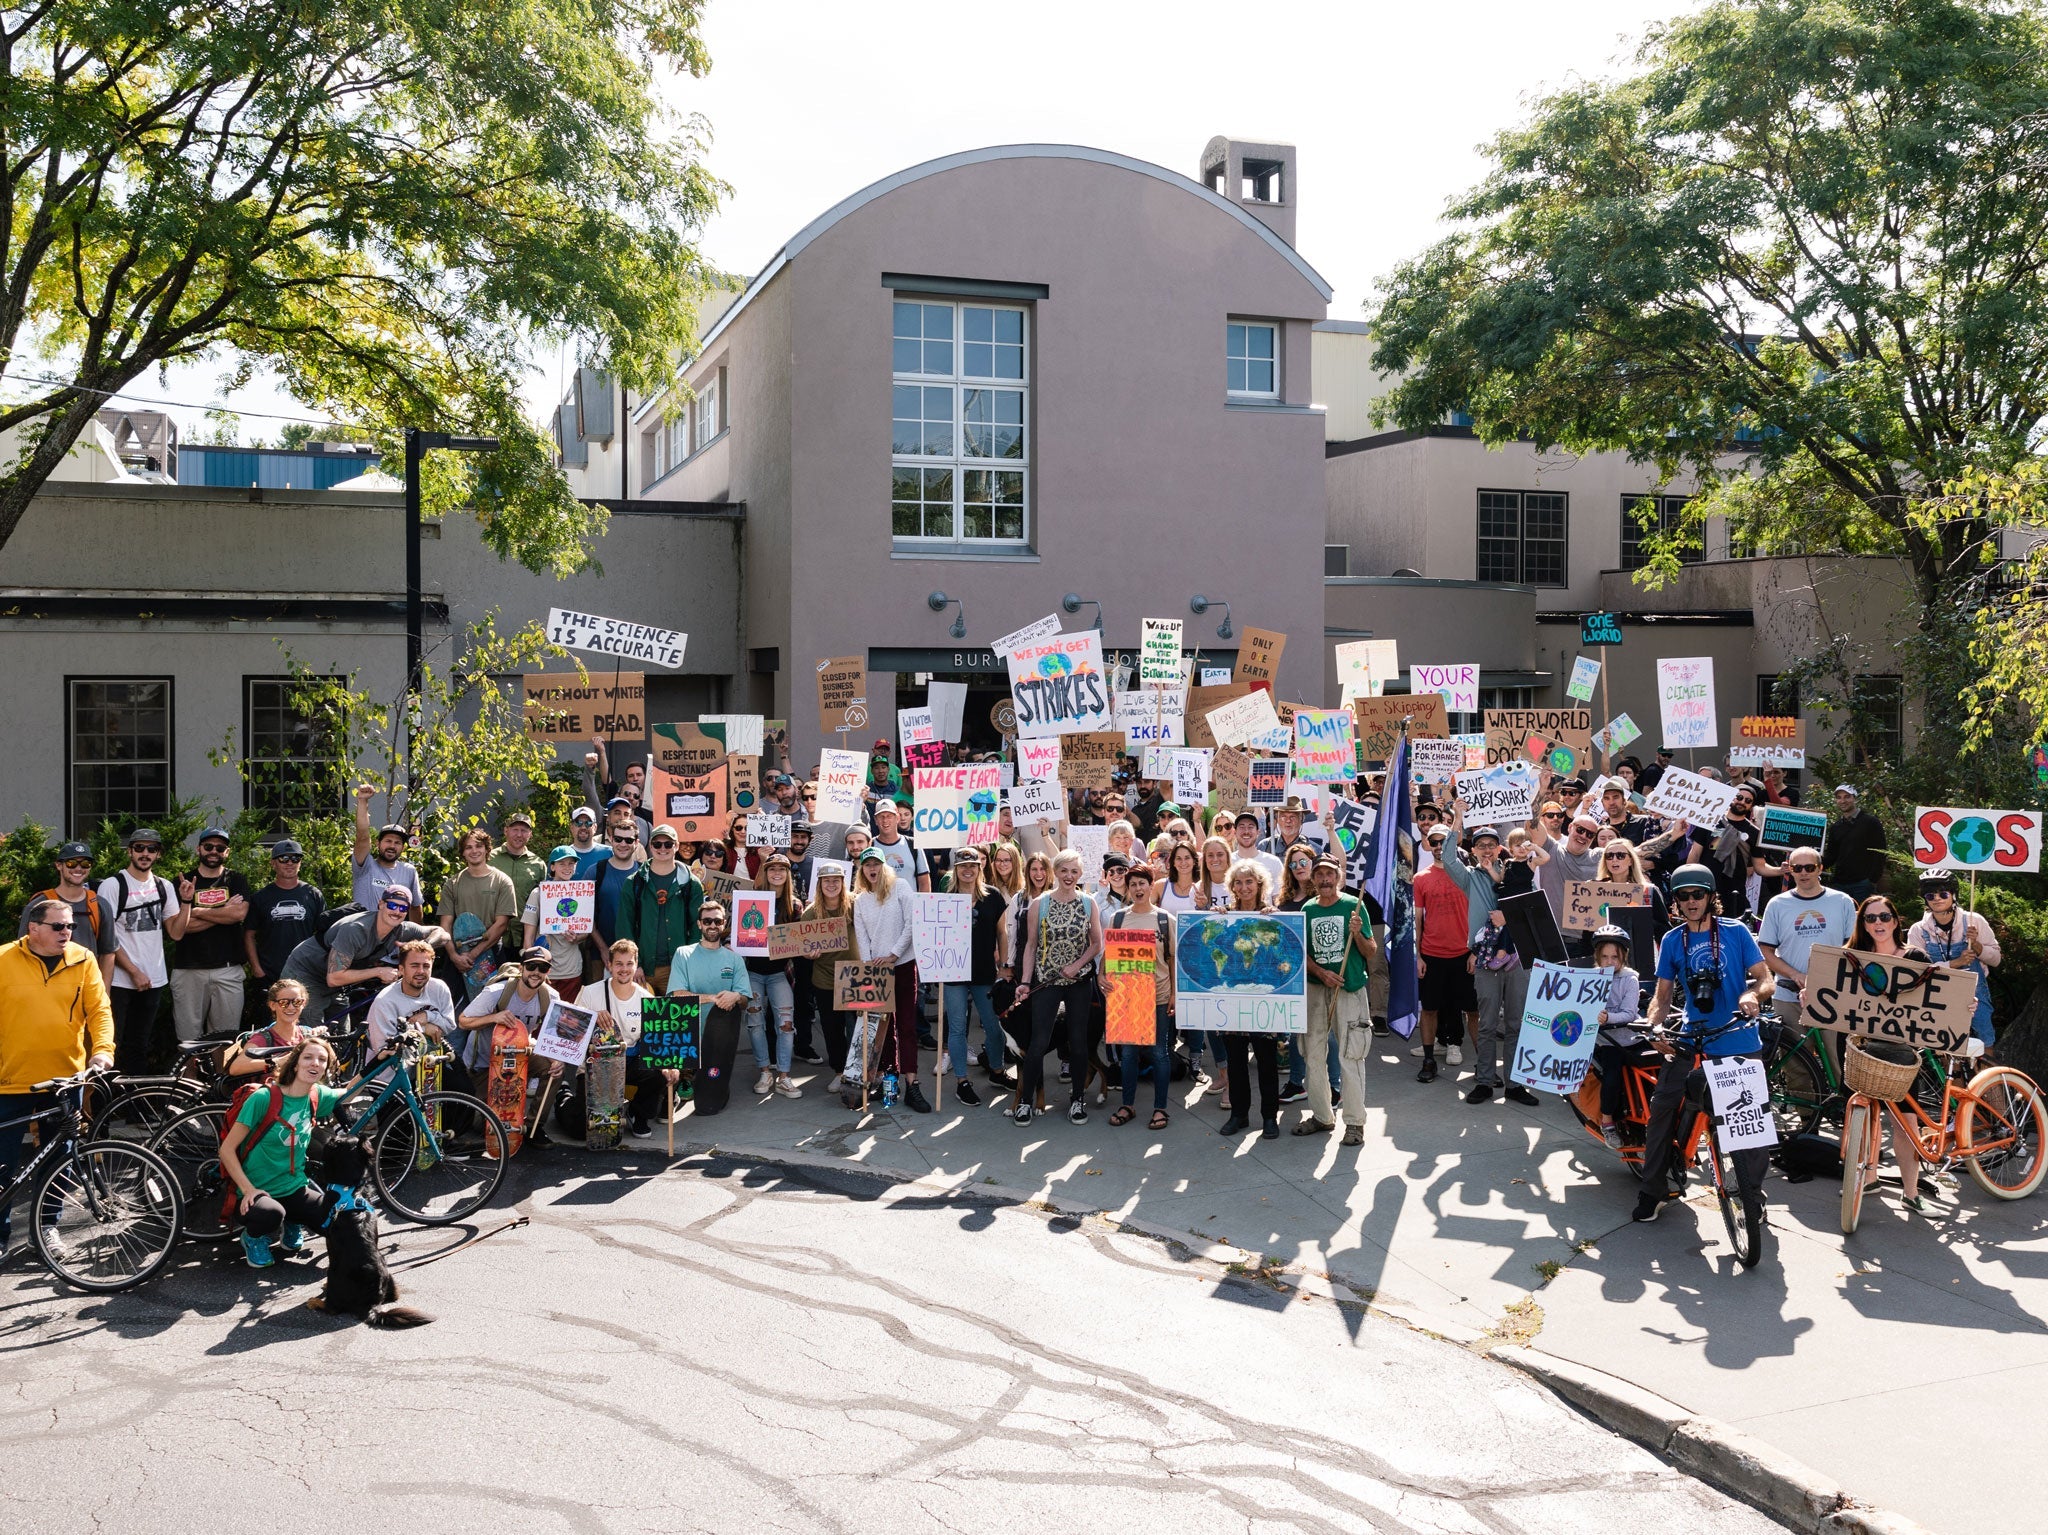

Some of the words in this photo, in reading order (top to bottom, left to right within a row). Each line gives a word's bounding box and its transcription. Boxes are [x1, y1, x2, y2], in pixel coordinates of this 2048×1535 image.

[561, 611, 600, 629] THE
[605, 620, 679, 645] SCIENCE
[1170, 622, 1181, 631] UP
[1588, 613, 1615, 628] ONE
[1156, 632, 1173, 640] AND
[1252, 637, 1274, 650] ONLY
[552, 627, 576, 644] IS
[586, 634, 682, 664] ACCURATE
[1013, 649, 1033, 661] WE
[1065, 638, 1091, 653] GET
[1251, 651, 1268, 663] ONE
[821, 672, 847, 682] CLOSED
[847, 672, 861, 680] FOR
[1242, 663, 1269, 679] EARTH
[1417, 667, 1475, 686] YOUR
[822, 682, 855, 691] BUSINESS.
[1666, 685, 1707, 700] CLIMATE
[823, 692, 840, 700] OPEN
[1014, 672, 1105, 723] STRIKES
[1124, 694, 1145, 706] I'VE
[824, 701, 850, 709] ACTION.
[1672, 701, 1706, 718] ACTION
[594, 714, 643, 732] DEAD.
[1369, 721, 1384, 732] the
[1488, 711, 1590, 729] WATERWORLD
[904, 730, 912, 740] IS
[1131, 725, 1171, 739] IKEA
[1740, 725, 1796, 738] CLIMATE
[1062, 743, 1104, 754] ANSWER
[1109, 742, 1121, 751] IS
[1066, 734, 1090, 753] THE
[1367, 731, 1397, 758] AREA
[1415, 743, 1459, 752] FIGHTING
[663, 750, 697, 760] RESPECT
[700, 749, 716, 760] OUR
[904, 745, 917, 758] I
[1023, 745, 1059, 759] WAKE
[1432, 753, 1460, 761] CHANGE
[1730, 744, 1805, 759] EMERGENCY
[908, 752, 942, 768] THE
[1178, 759, 1192, 768] KEEP
[668, 764, 711, 775] EXISTANCE
[1030, 762, 1053, 777] UP
[684, 779, 696, 789] OR
[918, 769, 967, 790] MAKE
[969, 768, 1000, 789] EARTH
[1250, 774, 1287, 790] NOW
[1458, 776, 1486, 794] SAVE
[1666, 773, 1707, 794] COAL,
[1025, 788, 1041, 798] GET
[1178, 791, 1203, 799] GROUND
[1463, 790, 1493, 812] BABY
[1494, 789, 1529, 807] SHARK
[1014, 801, 1060, 816] RADICAL
[1665, 787, 1725, 816] REALLY?
[915, 807, 968, 832] COOL
[760, 823, 767, 832] YA
[967, 821, 1000, 845] AGAIN
[1765, 820, 1821, 837] ENVIRONMENTAL
[748, 834, 769, 844] DUMB
[772, 835, 791, 845] IDIOTS
[1764, 831, 1790, 842] JUSTICE
[1915, 810, 2035, 867] SOS
[713, 876, 741, 890] THIS
[924, 900, 964, 923] LET
[1571, 898, 1592, 913] for
[776, 926, 786, 938] I
[800, 922, 827, 934] LOVE
[935, 927, 953, 945] IT
[1106, 931, 1126, 942] OUR
[1127, 931, 1156, 943] HOUSE
[803, 936, 848, 953] SEASONS
[922, 947, 969, 970] SNOW
[1118, 948, 1135, 958] IS
[1138, 948, 1153, 958] ON
[840, 966, 859, 980] NO
[864, 965, 895, 977] SNOW
[849, 977, 887, 988] LOW
[1536, 971, 1571, 1001] NO
[1835, 958, 1949, 1010] HOPE
[842, 987, 891, 1004] BLOW
[643, 998, 670, 1015] MY
[669, 1003, 700, 1020] DOG
[1178, 998, 1228, 1028] IT'S
[1858, 999, 1871, 1010] IS
[1878, 1002, 1919, 1019] NOT
[643, 1020, 689, 1032] NEEDS
[643, 1032, 692, 1045] CLEAN
[649, 1046, 698, 1058] WATER
[1517, 1046, 1536, 1073] IS
[1713, 1070, 1738, 1080] BREAK
[1738, 1066, 1757, 1076] FREE
[1716, 1079, 1737, 1088] FROM
[1725, 1108, 1764, 1125] FOSSIL
[1730, 1121, 1765, 1138] FUELS
